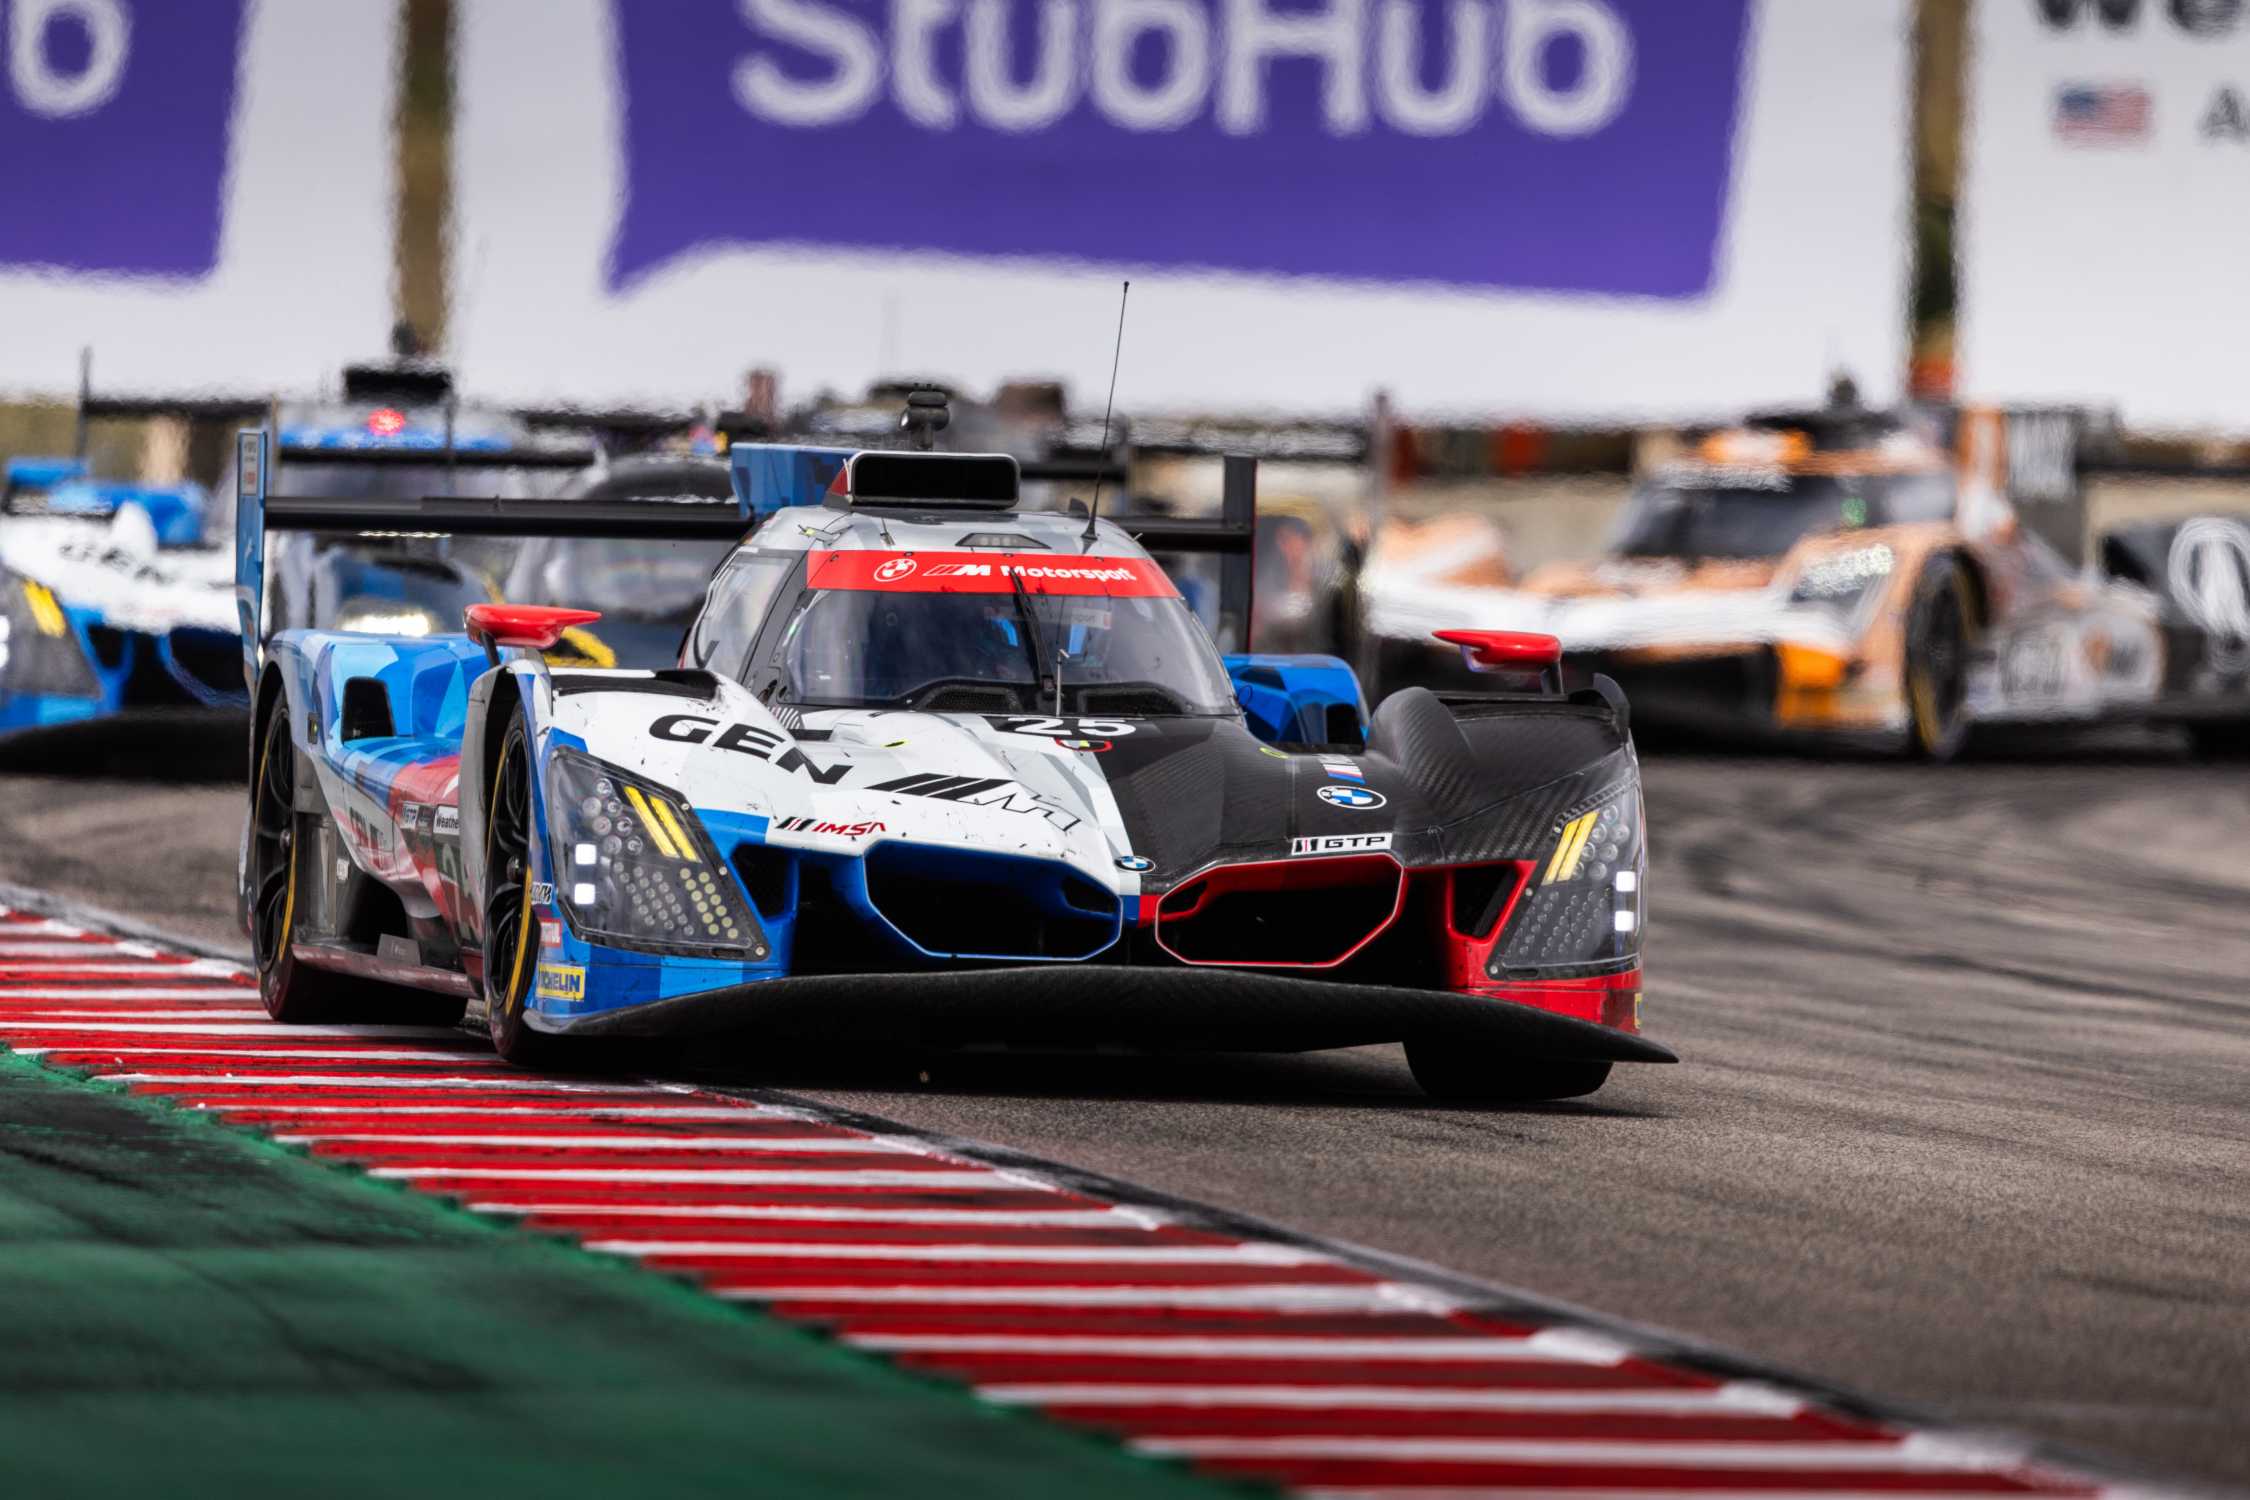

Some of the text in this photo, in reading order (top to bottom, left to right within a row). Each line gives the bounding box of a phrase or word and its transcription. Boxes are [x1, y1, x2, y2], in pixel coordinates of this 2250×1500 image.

[732, 0, 1635, 136] StubHub
[1000, 565, 1137, 582] Motorsport
[1007, 717, 1137, 737] 25
[648, 713, 854, 785] GEN
[811, 822, 886, 836] IMSA
[1324, 836, 1385, 849] GTP
